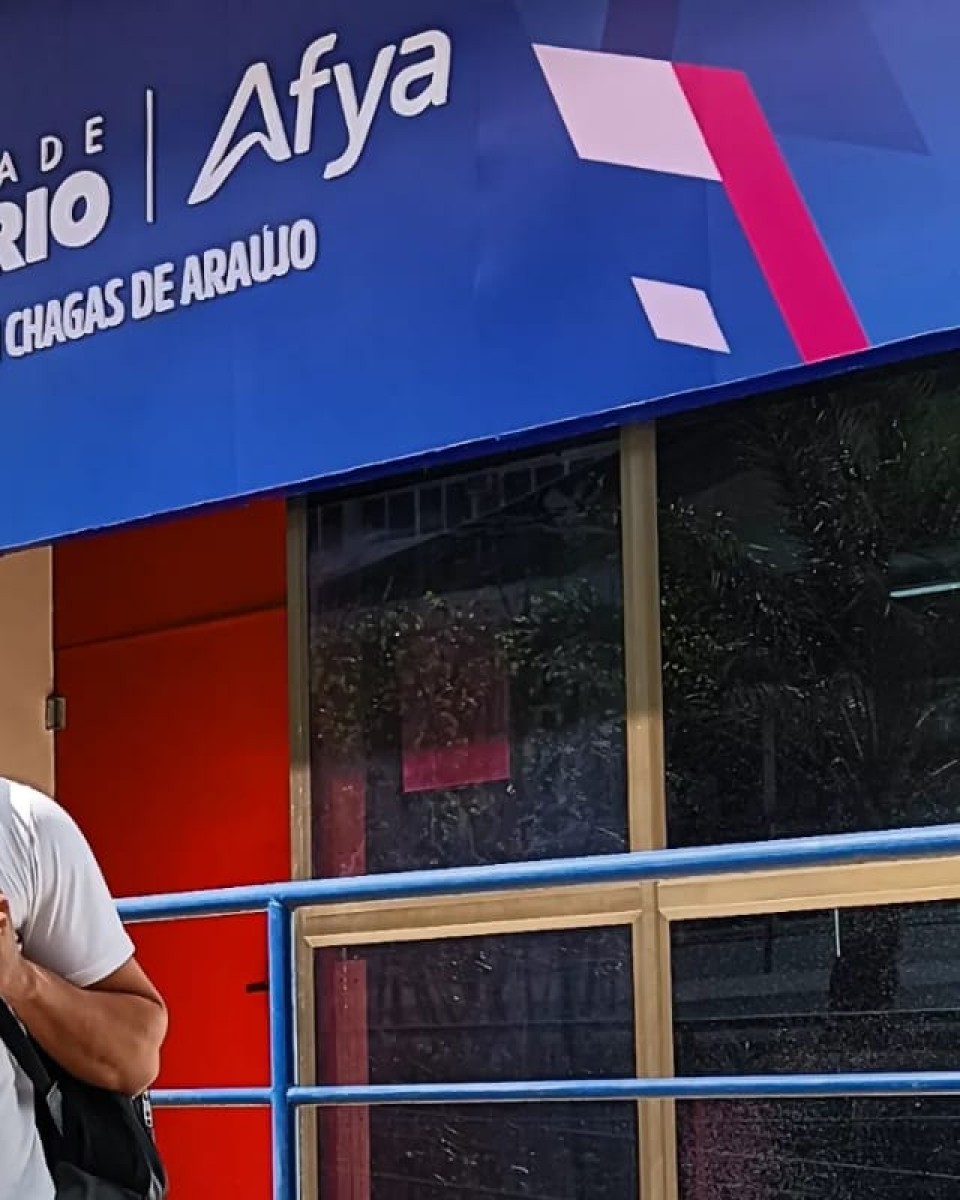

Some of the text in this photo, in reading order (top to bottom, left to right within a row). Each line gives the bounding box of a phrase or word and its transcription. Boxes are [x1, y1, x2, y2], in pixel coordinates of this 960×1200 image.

[187, 29, 452, 205] Afya
[5, 278, 125, 357] CHAGAS
[131, 262, 175, 320] DE
[179, 218, 317, 305] ARAÚJO
